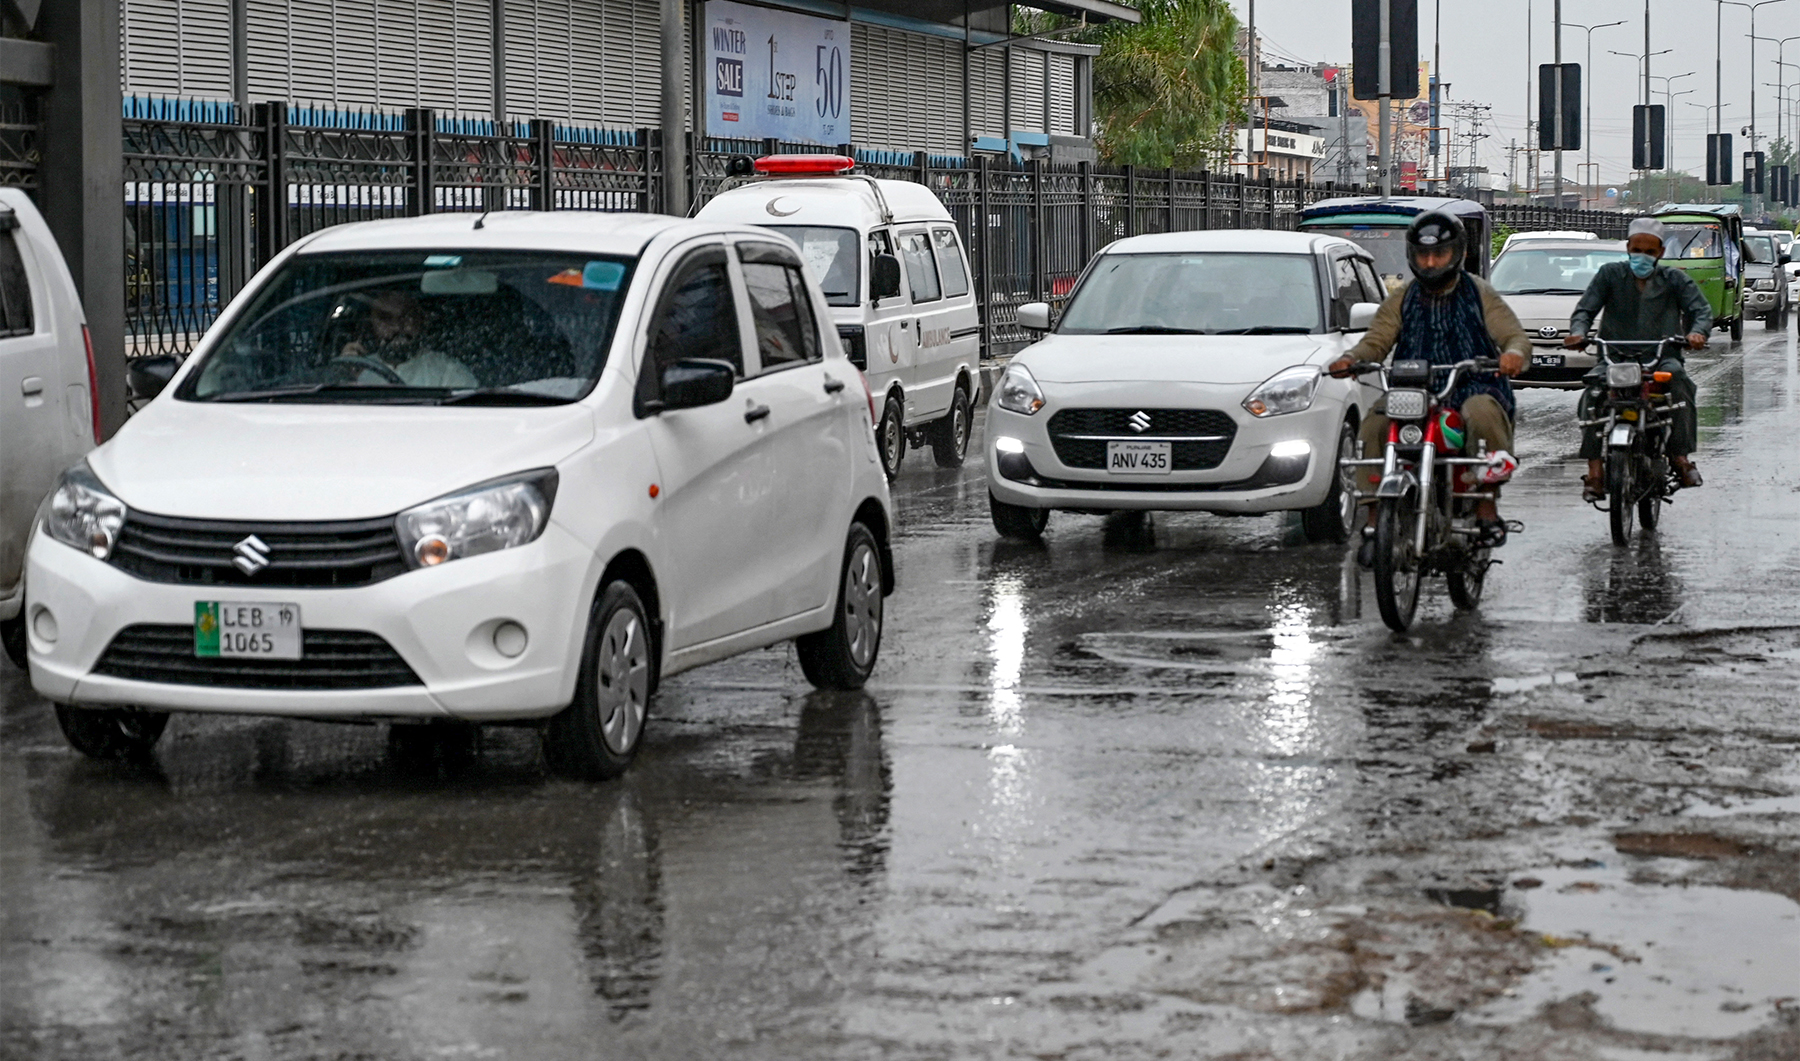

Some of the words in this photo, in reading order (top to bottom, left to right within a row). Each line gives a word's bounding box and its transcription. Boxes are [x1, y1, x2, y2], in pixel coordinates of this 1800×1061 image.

[713, 27, 747, 55] WINTER
[717, 62, 742, 92] SALE
[816, 45, 843, 119] 50
[922, 326, 951, 349] AMBULANCE
[1112, 453, 1138, 468] ANV
[1141, 453, 1167, 468] 435
[223, 607, 263, 627] LEB
[279, 609, 293, 626] 19
[223, 632, 274, 653] 1065
